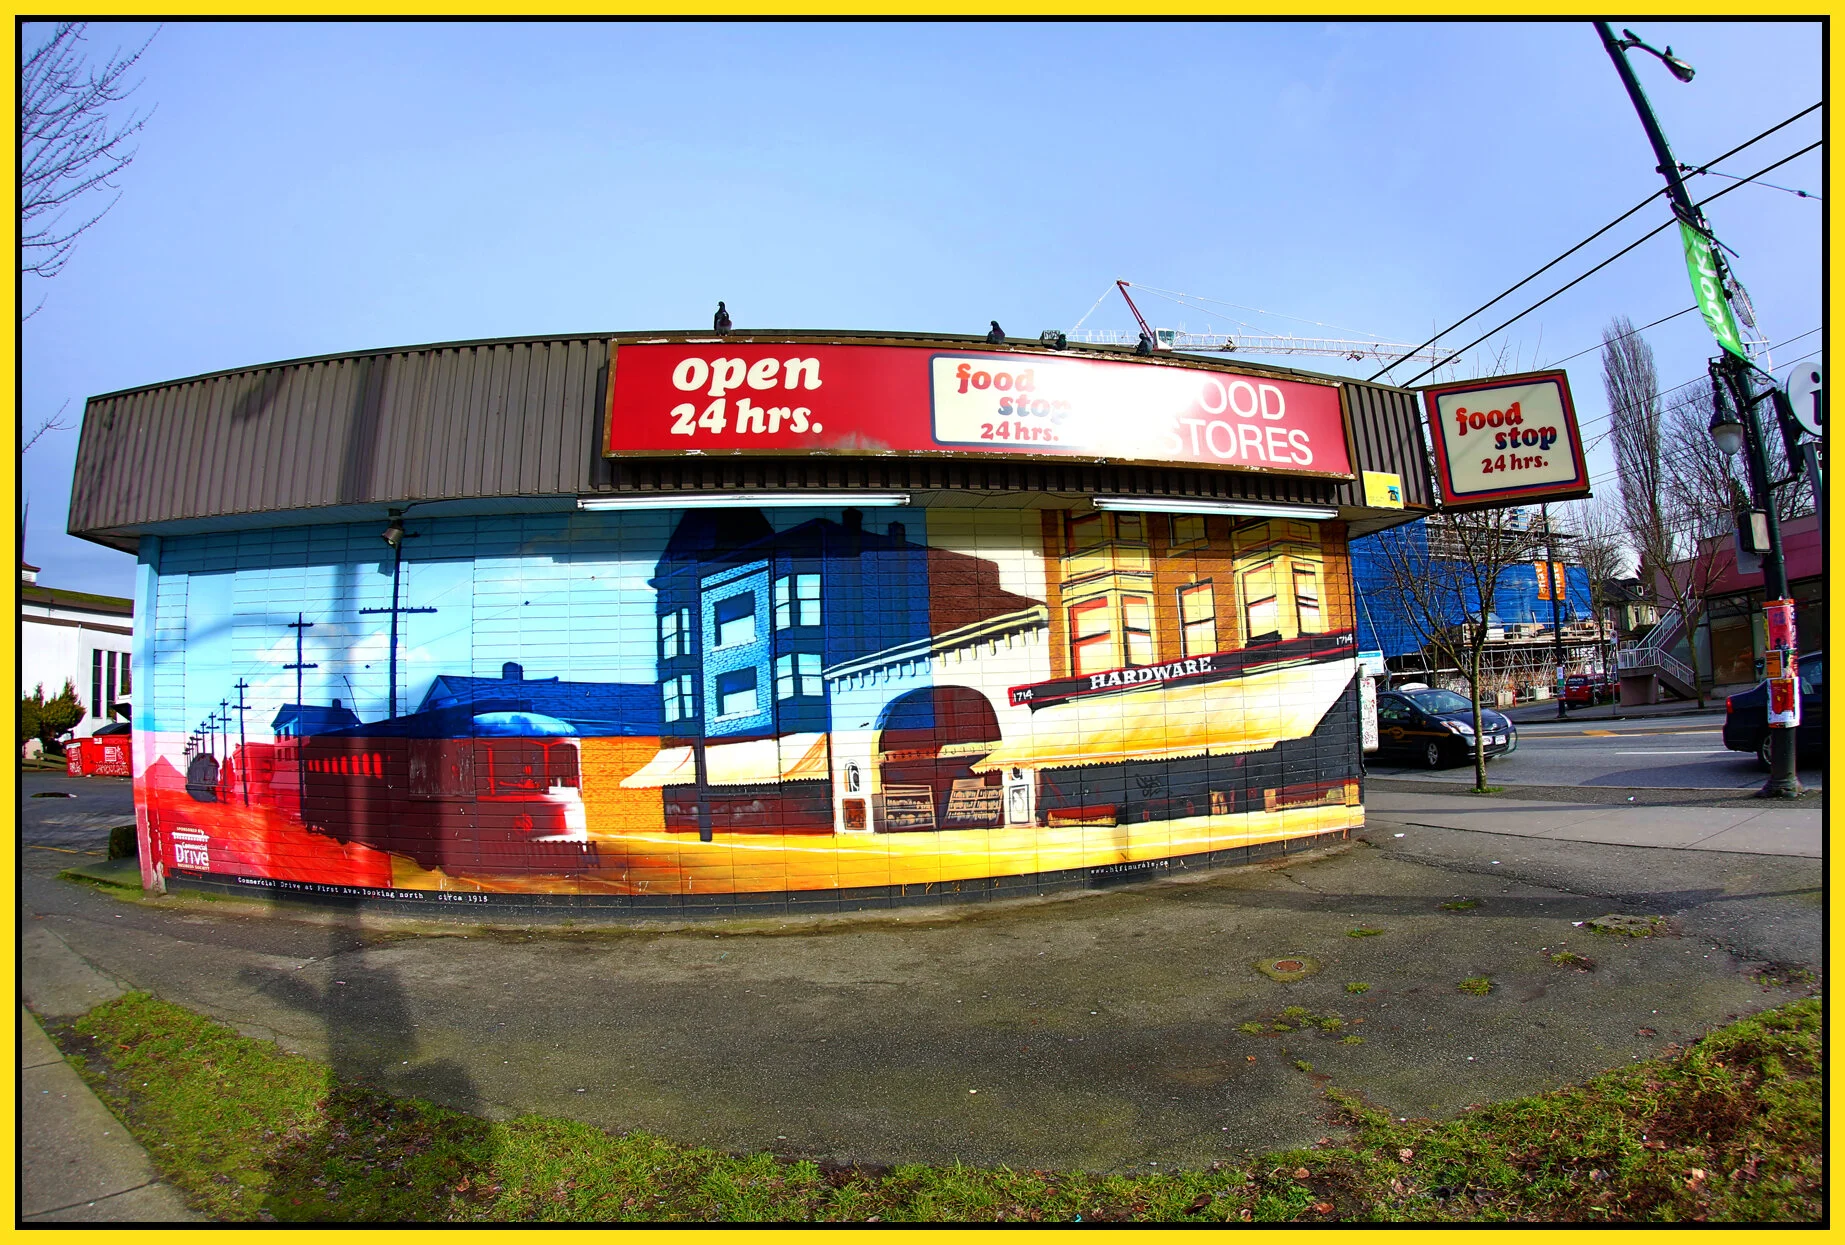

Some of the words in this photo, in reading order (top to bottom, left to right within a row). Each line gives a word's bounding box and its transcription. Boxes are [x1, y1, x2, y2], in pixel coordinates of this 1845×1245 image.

[672, 357, 823, 397] open
[956, 363, 1036, 394] food
[998, 394, 1073, 425] stop
[1201, 377, 1286, 420] OOD
[670, 398, 727, 436] 24
[735, 398, 823, 434] hrs.
[980, 421, 1010, 440] 24
[1014, 421, 1059, 442] hrs.
[1456, 402, 1523, 436] food
[1163, 415, 1313, 466] STORES
[1495, 426, 1557, 450] stop
[1481, 454, 1506, 473] 24
[1509, 454, 1548, 471] hrs.
[1336, 633, 1353, 645] 1714
[1089, 656, 1217, 690] HARDWARE.
[1013, 689, 1034, 703] 1714
[175, 843, 209, 867] Drive
[238, 877, 276, 887] Commercial
[280, 881, 301, 889] Drive
[317, 885, 339, 893] First
[343, 887, 361, 895] Ave.
[363, 888, 395, 898] looking
